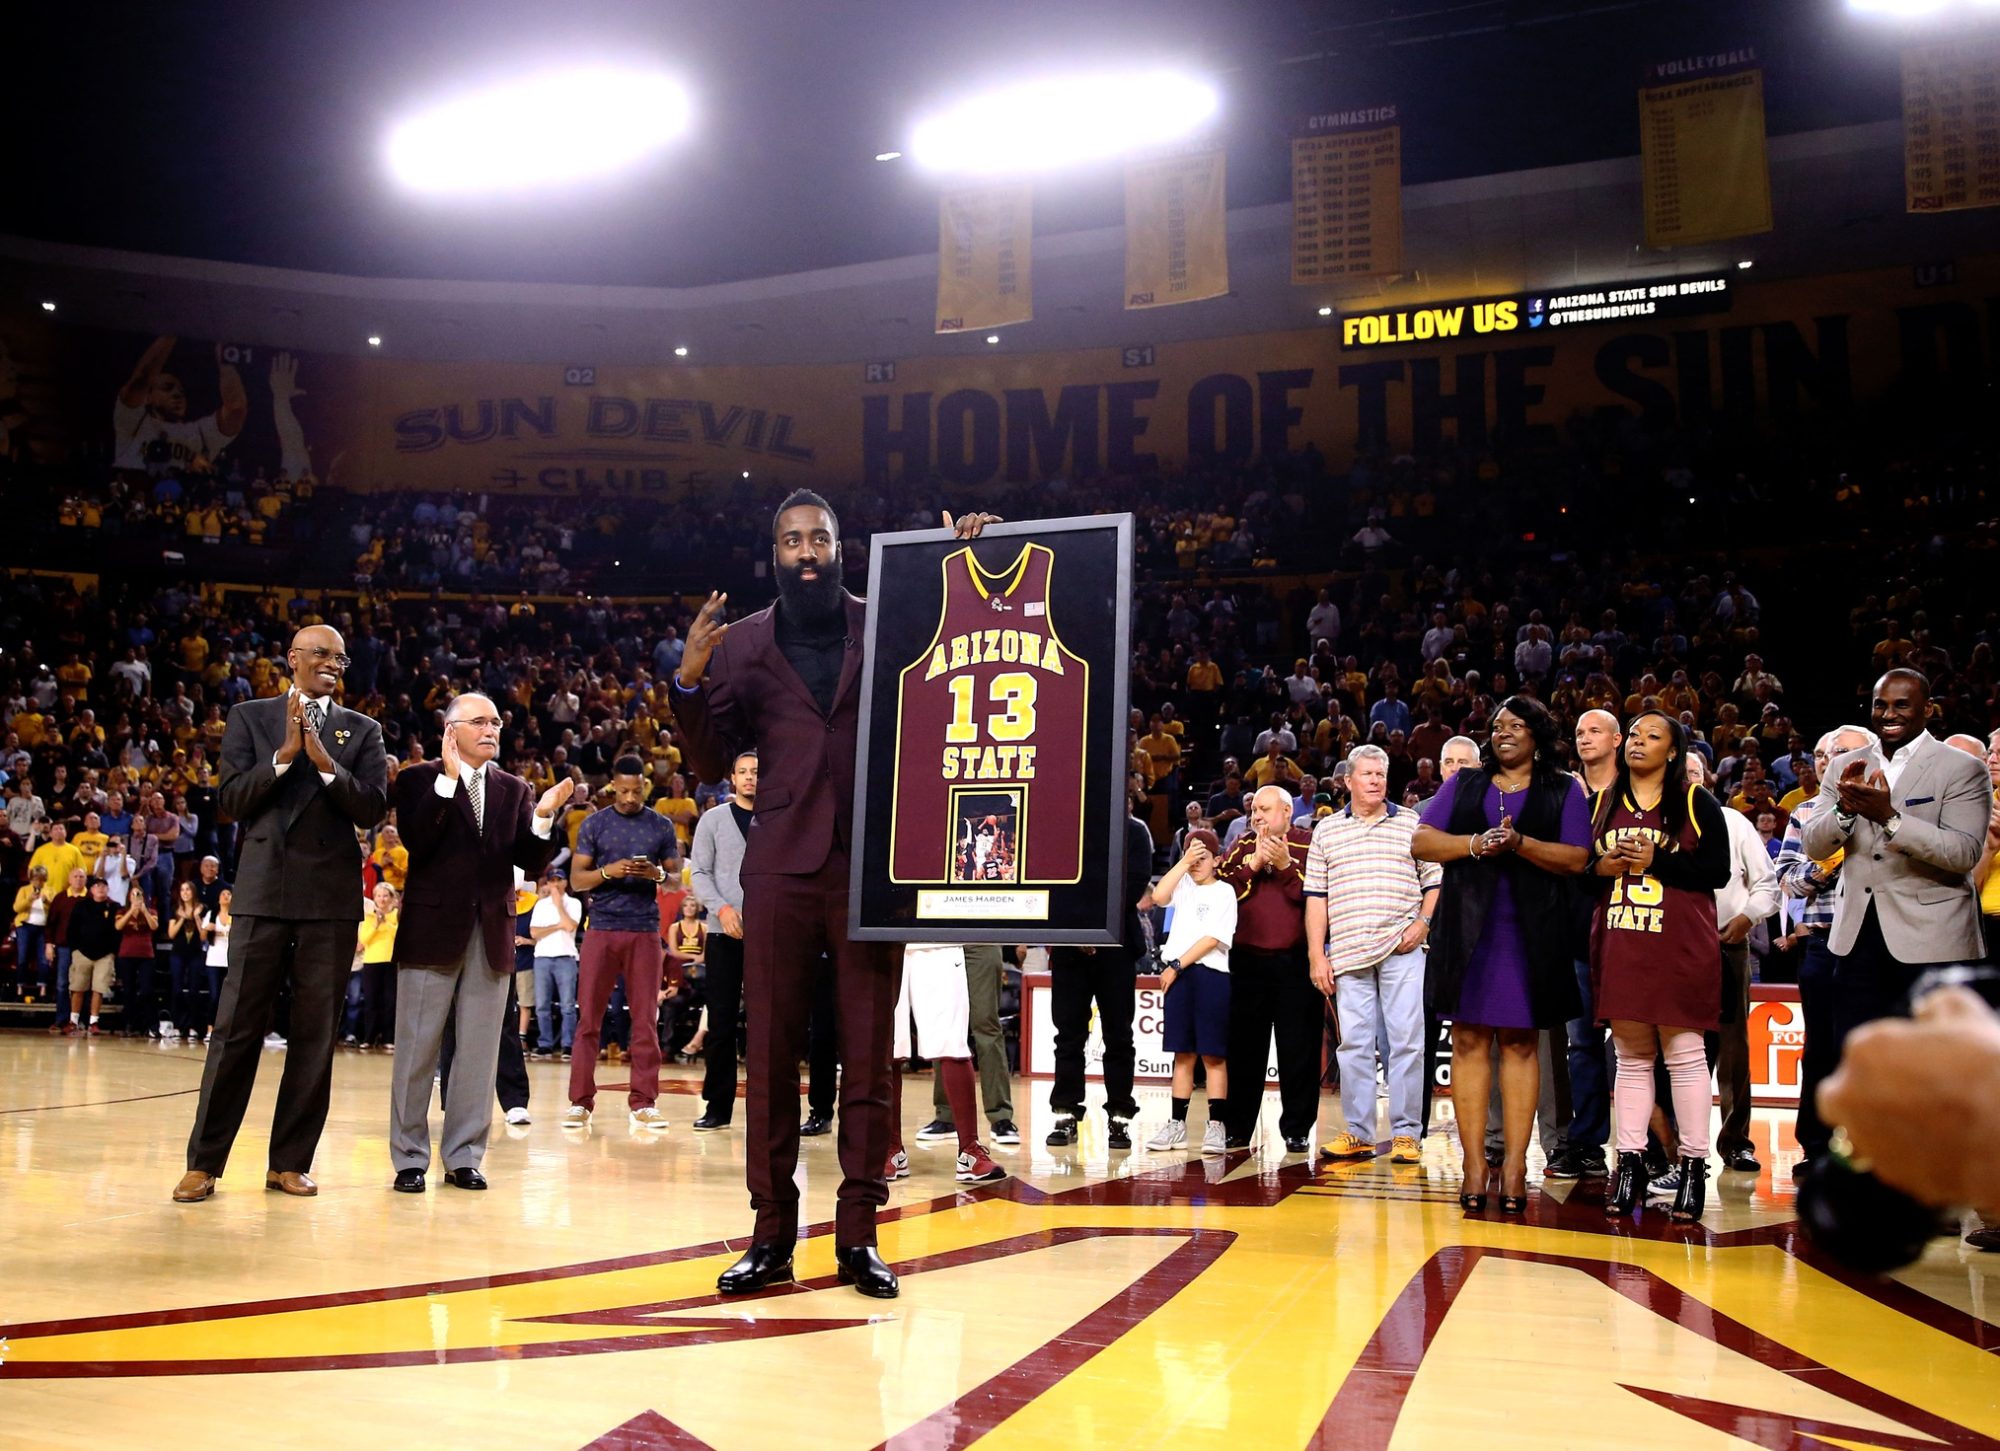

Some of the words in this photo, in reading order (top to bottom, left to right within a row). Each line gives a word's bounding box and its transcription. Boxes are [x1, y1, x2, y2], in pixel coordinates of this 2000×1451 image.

[1656, 47, 1757, 77] VOLLEYBALL
[1309, 105, 1397, 129] GYMNASTICS
[1912, 195, 1943, 209] ASU
[1917, 265, 1954, 286] U1
[1549, 292, 1606, 309] ARIZONA
[1609, 287, 1647, 303] STATE
[1649, 284, 1677, 298] SUN
[1680, 279, 1727, 295] DEVILS
[1343, 306, 1465, 346] FOLLOW
[1472, 301, 1519, 333] US
[1549, 302, 1656, 326] @THESUNDEVILS
[223, 346, 253, 364] Q1
[1125, 348, 1153, 366] S1
[566, 369, 595, 385] Q2
[867, 363, 896, 381] R1
[862, 379, 1161, 485] HOME
[1187, 368, 1314, 460] OF
[1339, 346, 1559, 452] THE
[1594, 315, 1853, 428] SUN
[394, 397, 558, 453] SUN
[587, 397, 817, 465] DEVIL
[538, 467, 672, 492] CLUB
[924, 629, 1064, 682] ARIZONA
[945, 671, 1038, 743] 13
[942, 745, 1037, 780] STATE
[1594, 827, 1680, 857] RIZON
[943, 895, 973, 903] JAMES
[975, 895, 1015, 903] HARDEN
[1610, 864, 1664, 906] 13
[1607, 905, 1664, 933] STATE
